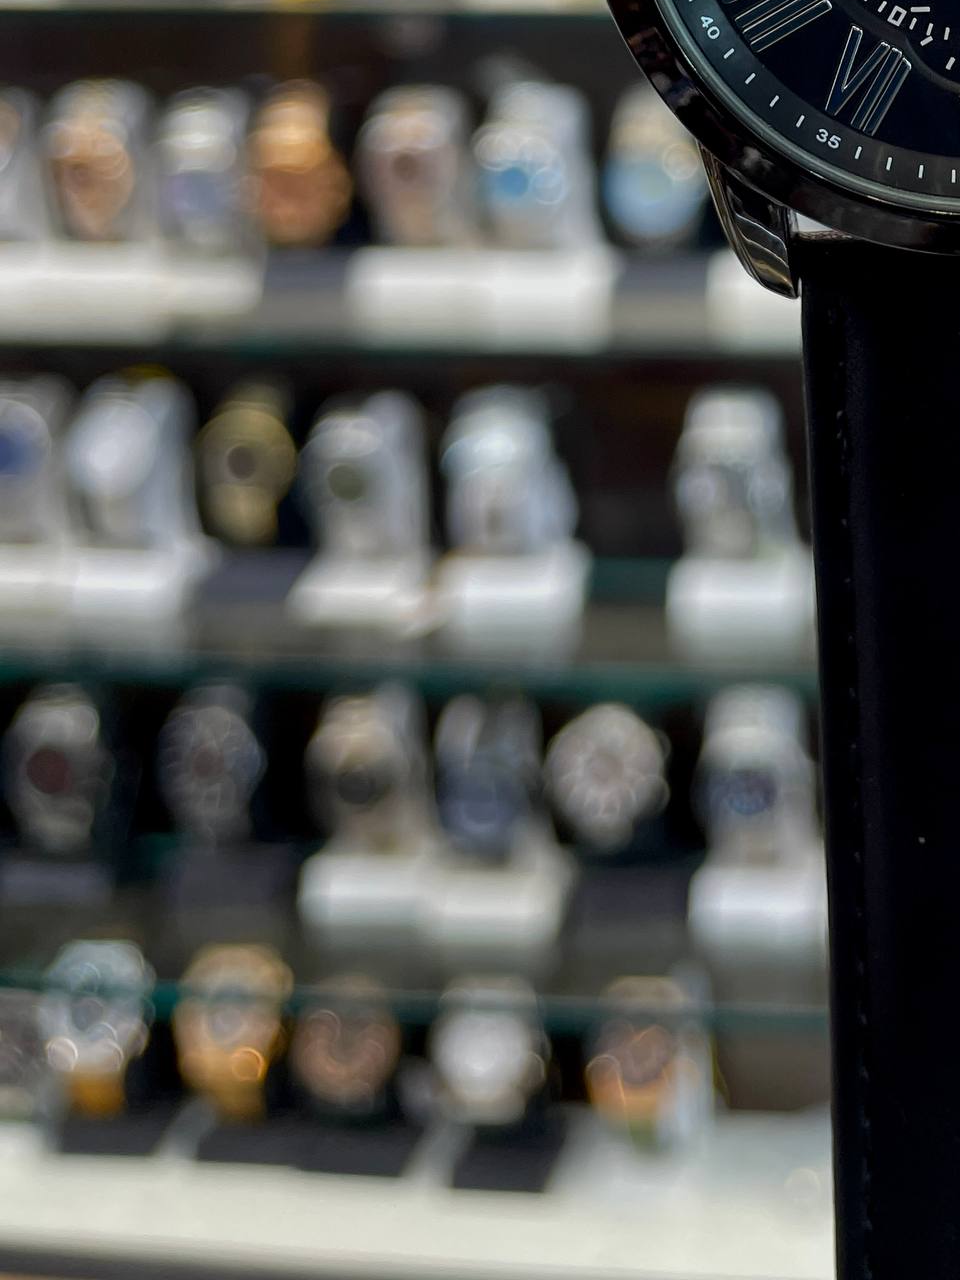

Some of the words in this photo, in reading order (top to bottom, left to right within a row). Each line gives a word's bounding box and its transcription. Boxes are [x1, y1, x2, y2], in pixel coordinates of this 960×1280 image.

[700, 15, 720, 40] 40
[825, 25, 912, 136] VII
[815, 128, 842, 149] 35
